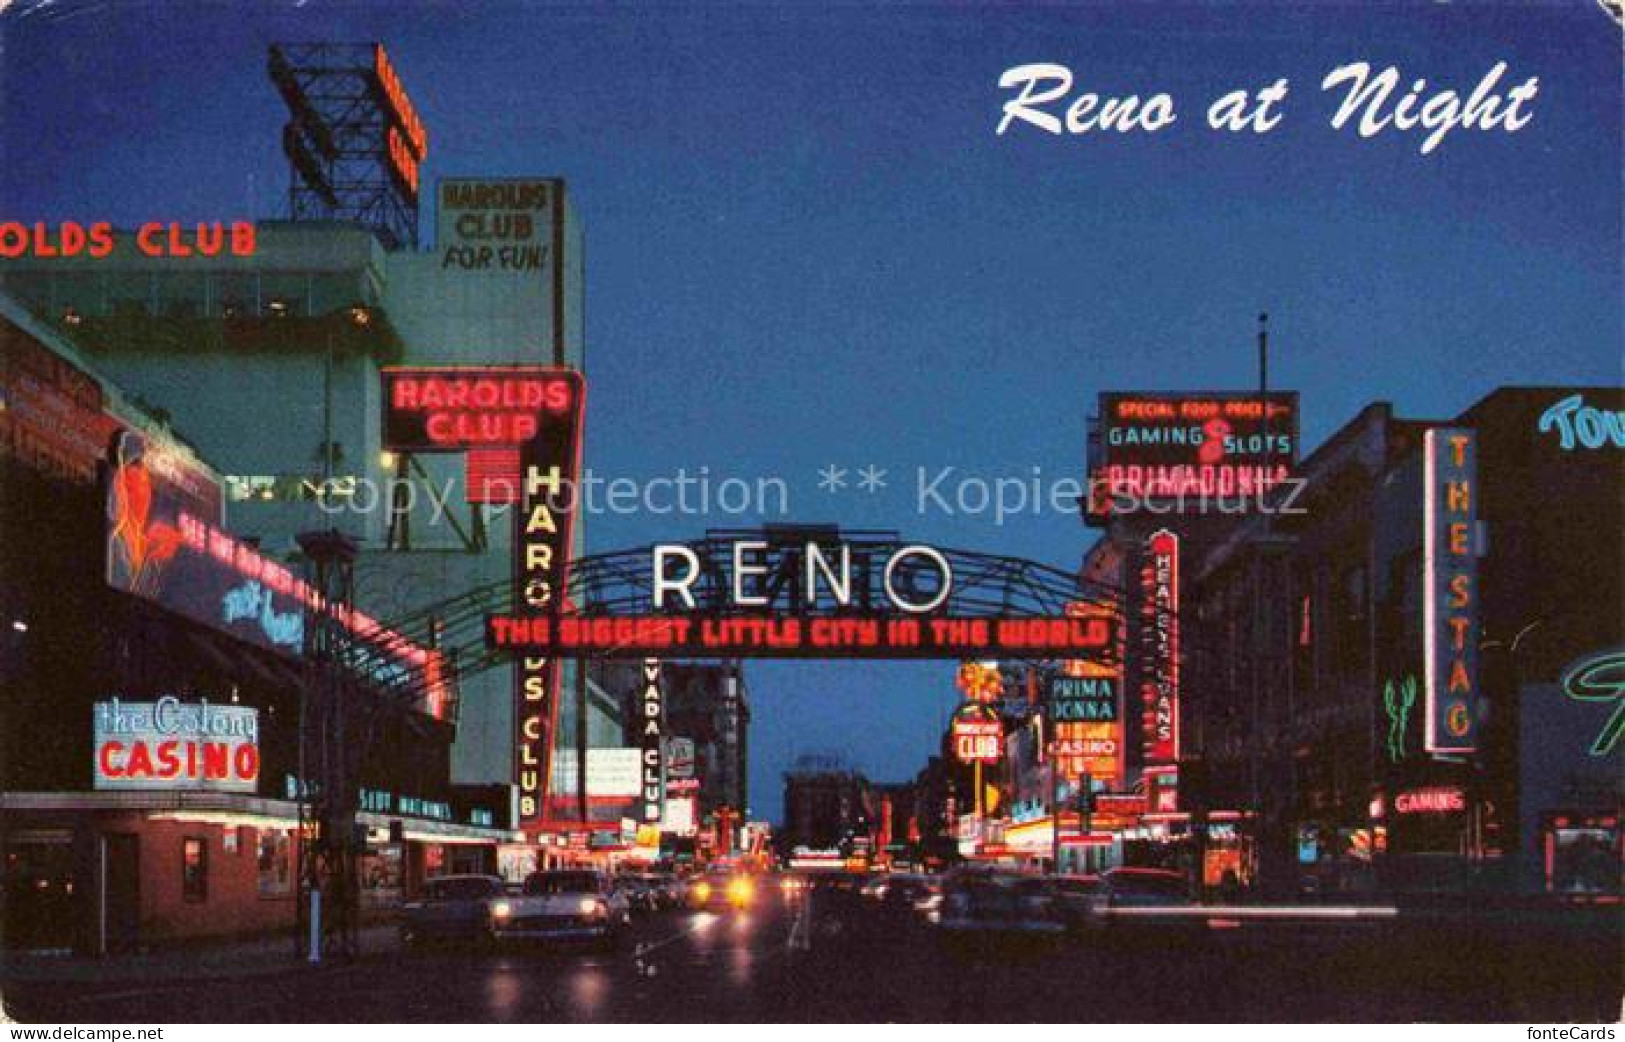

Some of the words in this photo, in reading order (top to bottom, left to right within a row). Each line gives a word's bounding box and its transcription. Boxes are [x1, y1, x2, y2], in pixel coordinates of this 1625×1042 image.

[0, 221, 114, 258] OLDS
[137, 221, 257, 258] CLUB
[455, 213, 534, 240] CLUB
[441, 246, 495, 271] FOR
[393, 379, 571, 410] HAROLDS
[425, 412, 538, 444] CLUB
[1109, 426, 1203, 447] GAMING
[1223, 433, 1291, 454] SLOTS
[1446, 435, 1471, 555] THE
[654, 540, 951, 612] RENO
[491, 616, 549, 646] THE
[558, 616, 692, 647] BIGGEST
[702, 617, 800, 647] LITTLE
[810, 617, 878, 647] CITY
[888, 617, 920, 646] IN
[931, 617, 989, 647] THE
[999, 617, 1110, 648] WORLD
[1446, 575, 1471, 738] STAG
[1053, 678, 1114, 698] PRIMA
[100, 696, 146, 734] the
[152, 695, 258, 746] Colony
[98, 740, 260, 780] CASINO
[520, 716, 545, 817] CLUB
